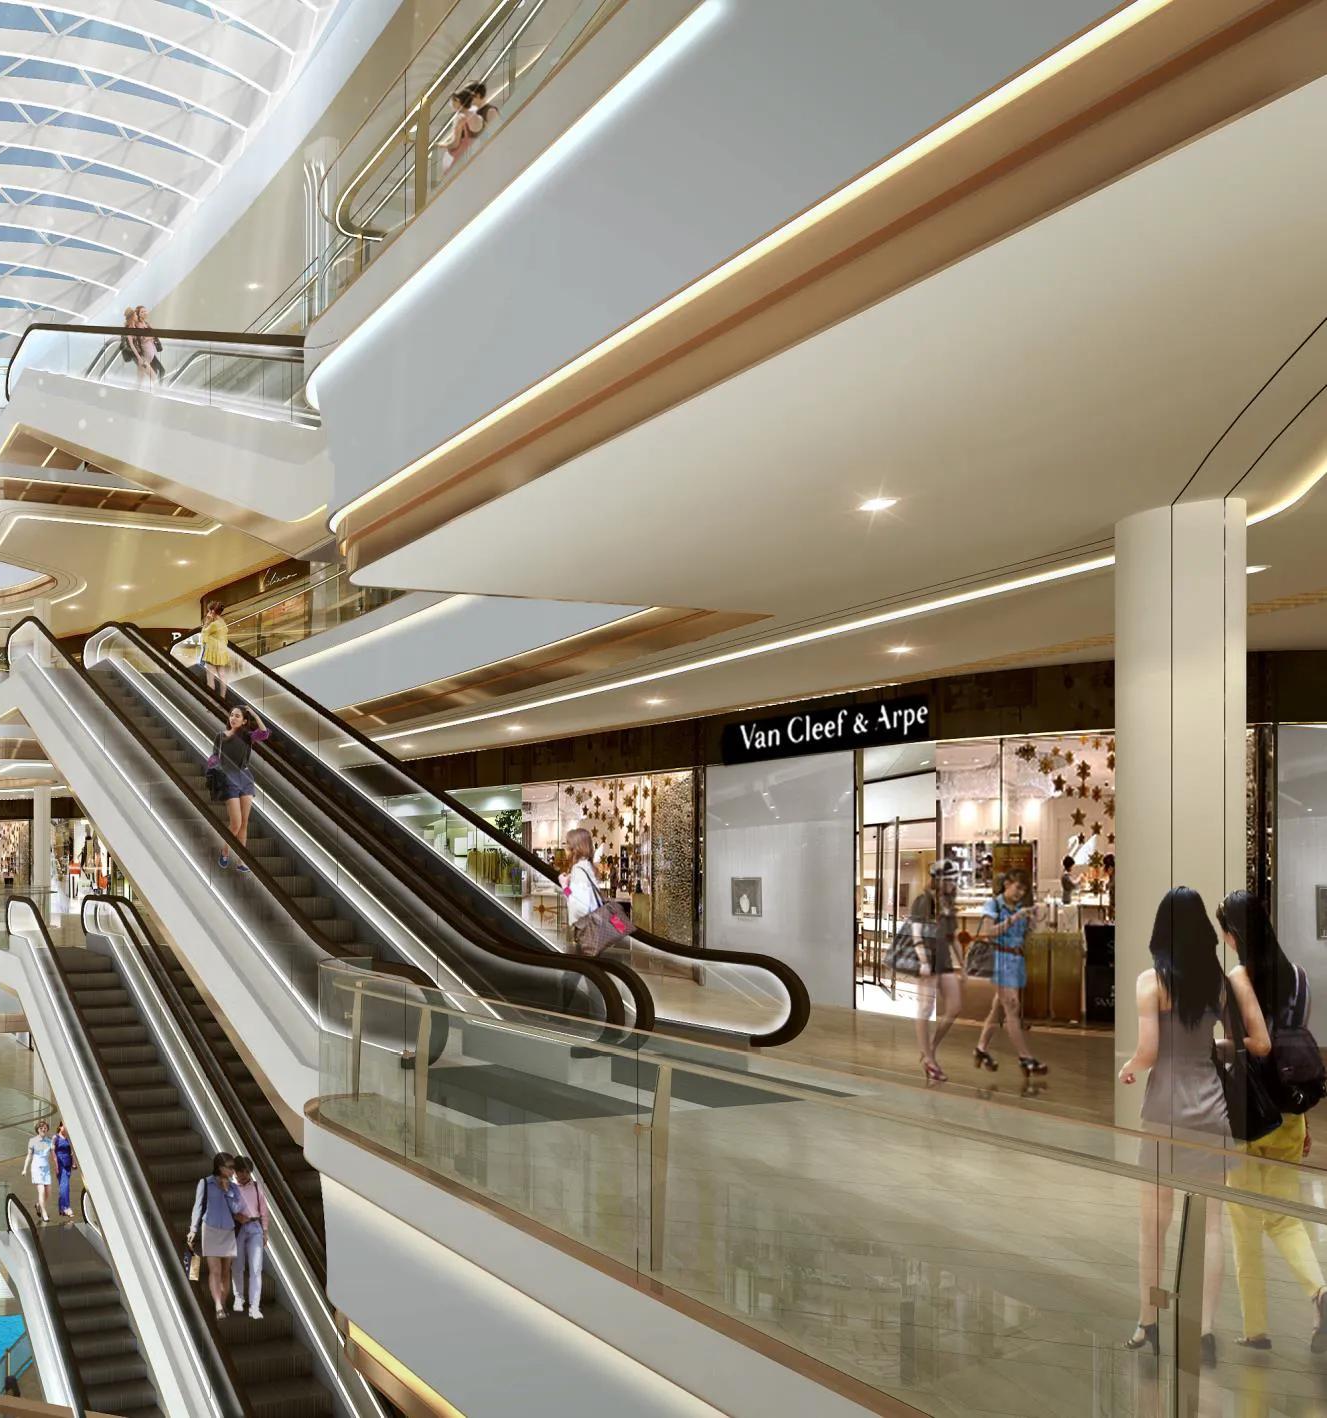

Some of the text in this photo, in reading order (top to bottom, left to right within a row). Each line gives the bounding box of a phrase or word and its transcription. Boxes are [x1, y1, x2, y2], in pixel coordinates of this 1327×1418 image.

[739, 704, 929, 750] Van Cleef & Arpe
